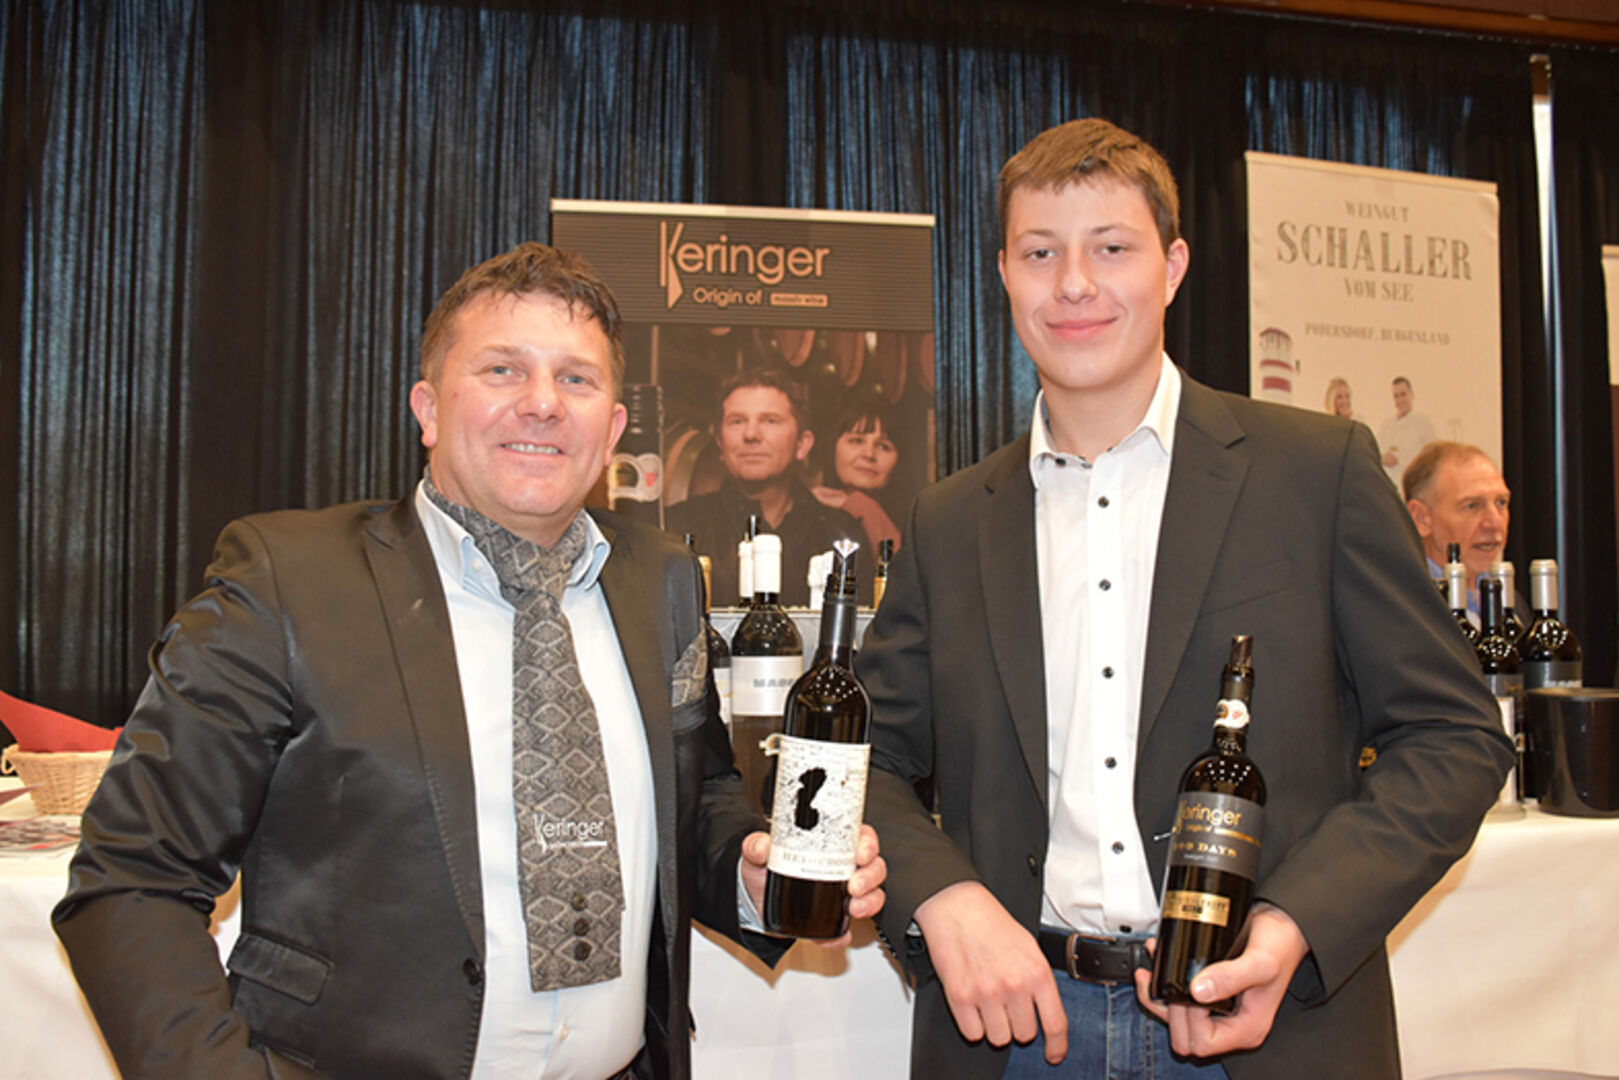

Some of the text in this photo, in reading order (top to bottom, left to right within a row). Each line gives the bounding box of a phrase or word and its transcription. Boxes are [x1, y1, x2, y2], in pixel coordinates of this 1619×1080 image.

[1345, 200, 1409, 223] WEINGUT
[660, 221, 831, 309] Keringer
[1277, 220, 1472, 281] SCHALLER
[692, 286, 743, 308] Origin
[745, 289, 763, 305] of
[1344, 278, 1414, 303] VOM SEE
[533, 813, 605, 855] Keringer
